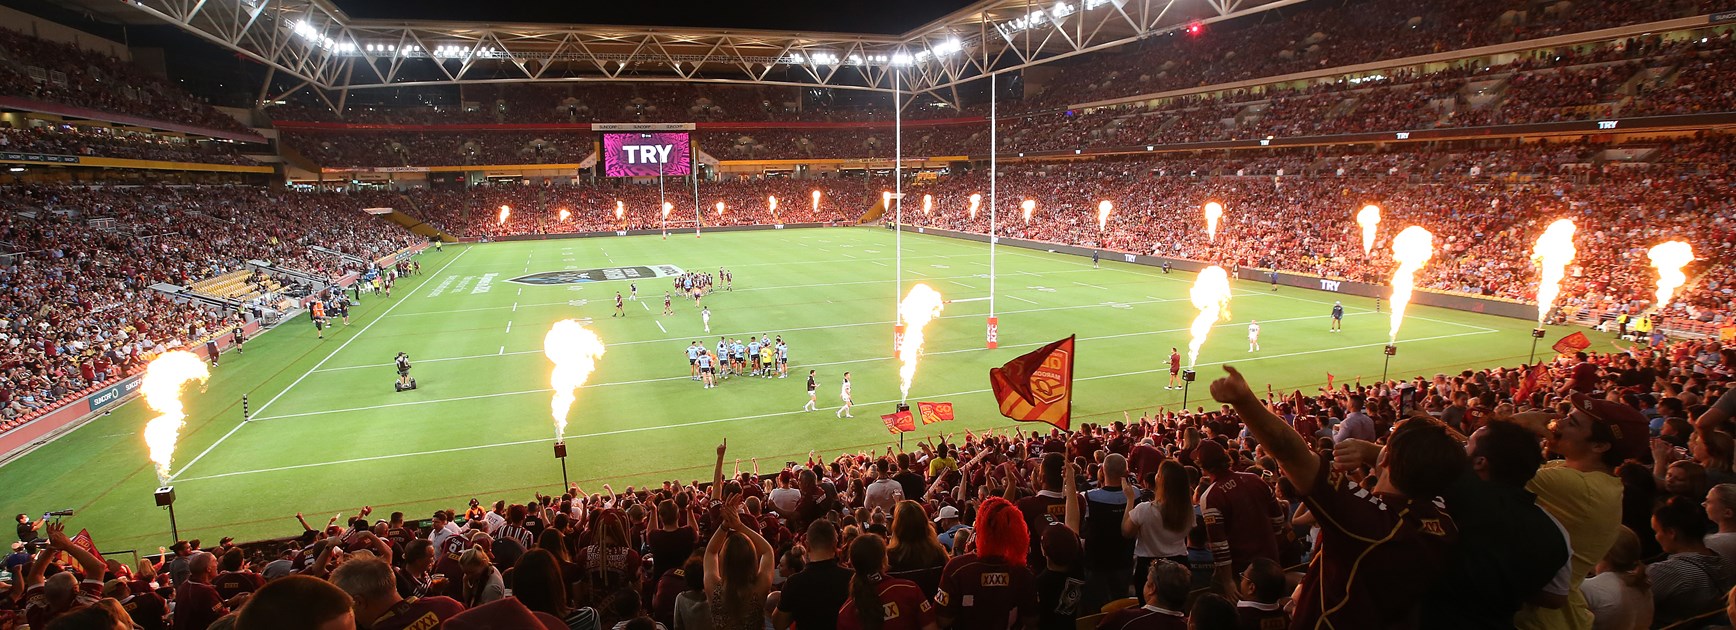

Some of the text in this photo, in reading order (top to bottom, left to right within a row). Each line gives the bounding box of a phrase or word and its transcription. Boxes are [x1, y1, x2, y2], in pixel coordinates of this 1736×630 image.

[1598, 121, 1618, 129] TRY
[622, 144, 673, 164] TRY
[1124, 254, 1136, 262] TRY
[1320, 280, 1340, 292] TRY
[94, 392, 112, 406] SUNCORP
[936, 404, 950, 413] GO
[984, 574, 1008, 584] XXXX
